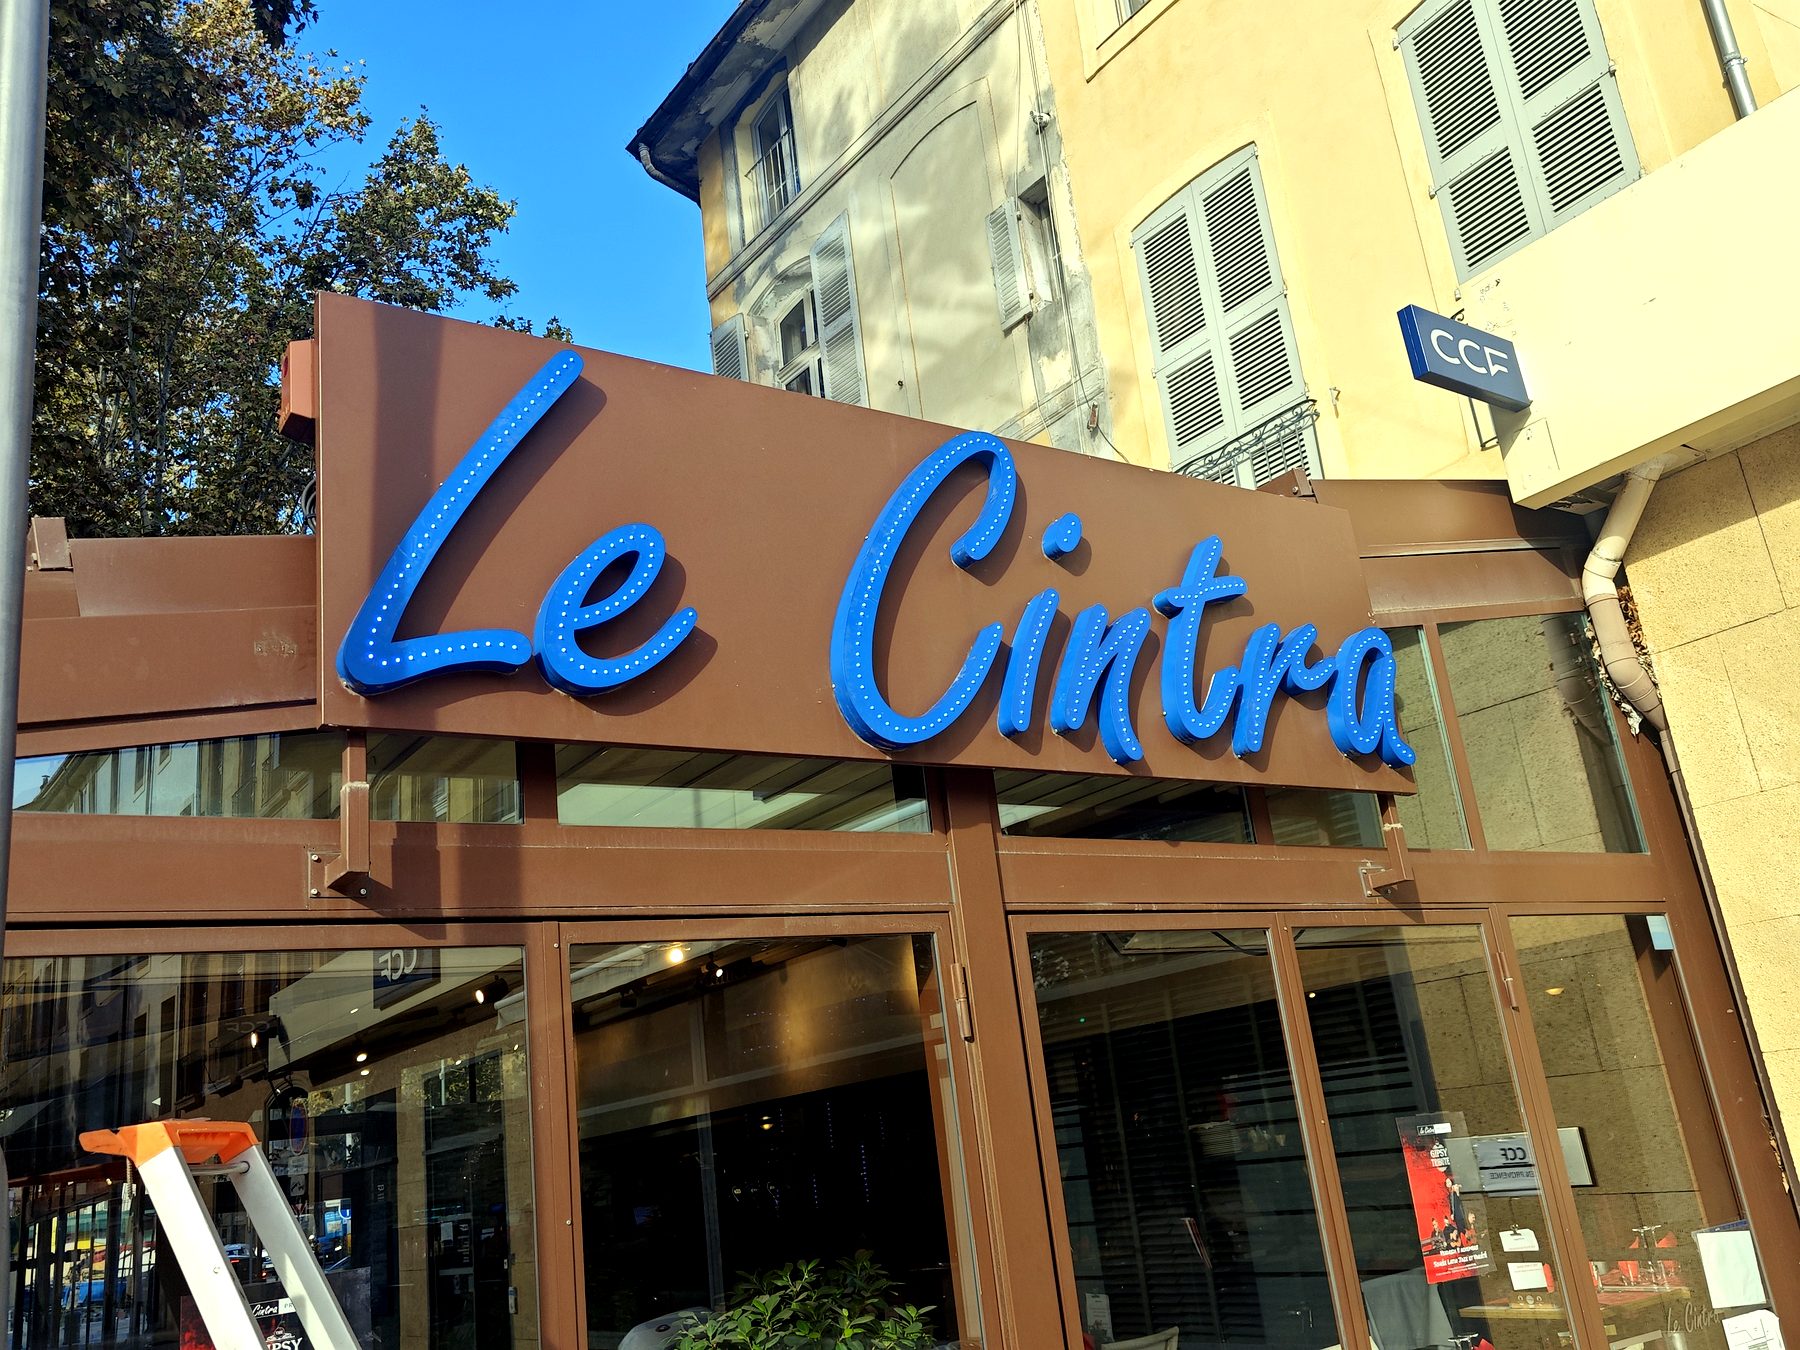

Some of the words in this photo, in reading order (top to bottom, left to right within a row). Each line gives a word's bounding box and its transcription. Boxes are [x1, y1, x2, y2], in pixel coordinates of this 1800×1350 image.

[1430, 328, 1509, 377] CCF
[335, 349, 698, 697] Le
[830, 431, 1416, 767] Cintra
[1430, 1147, 1448, 1158] GIPSY
[252, 1304, 278, 1317] Cintra
[1667, 1307, 1681, 1333] Le
[1684, 1302, 1721, 1333] Cintra
